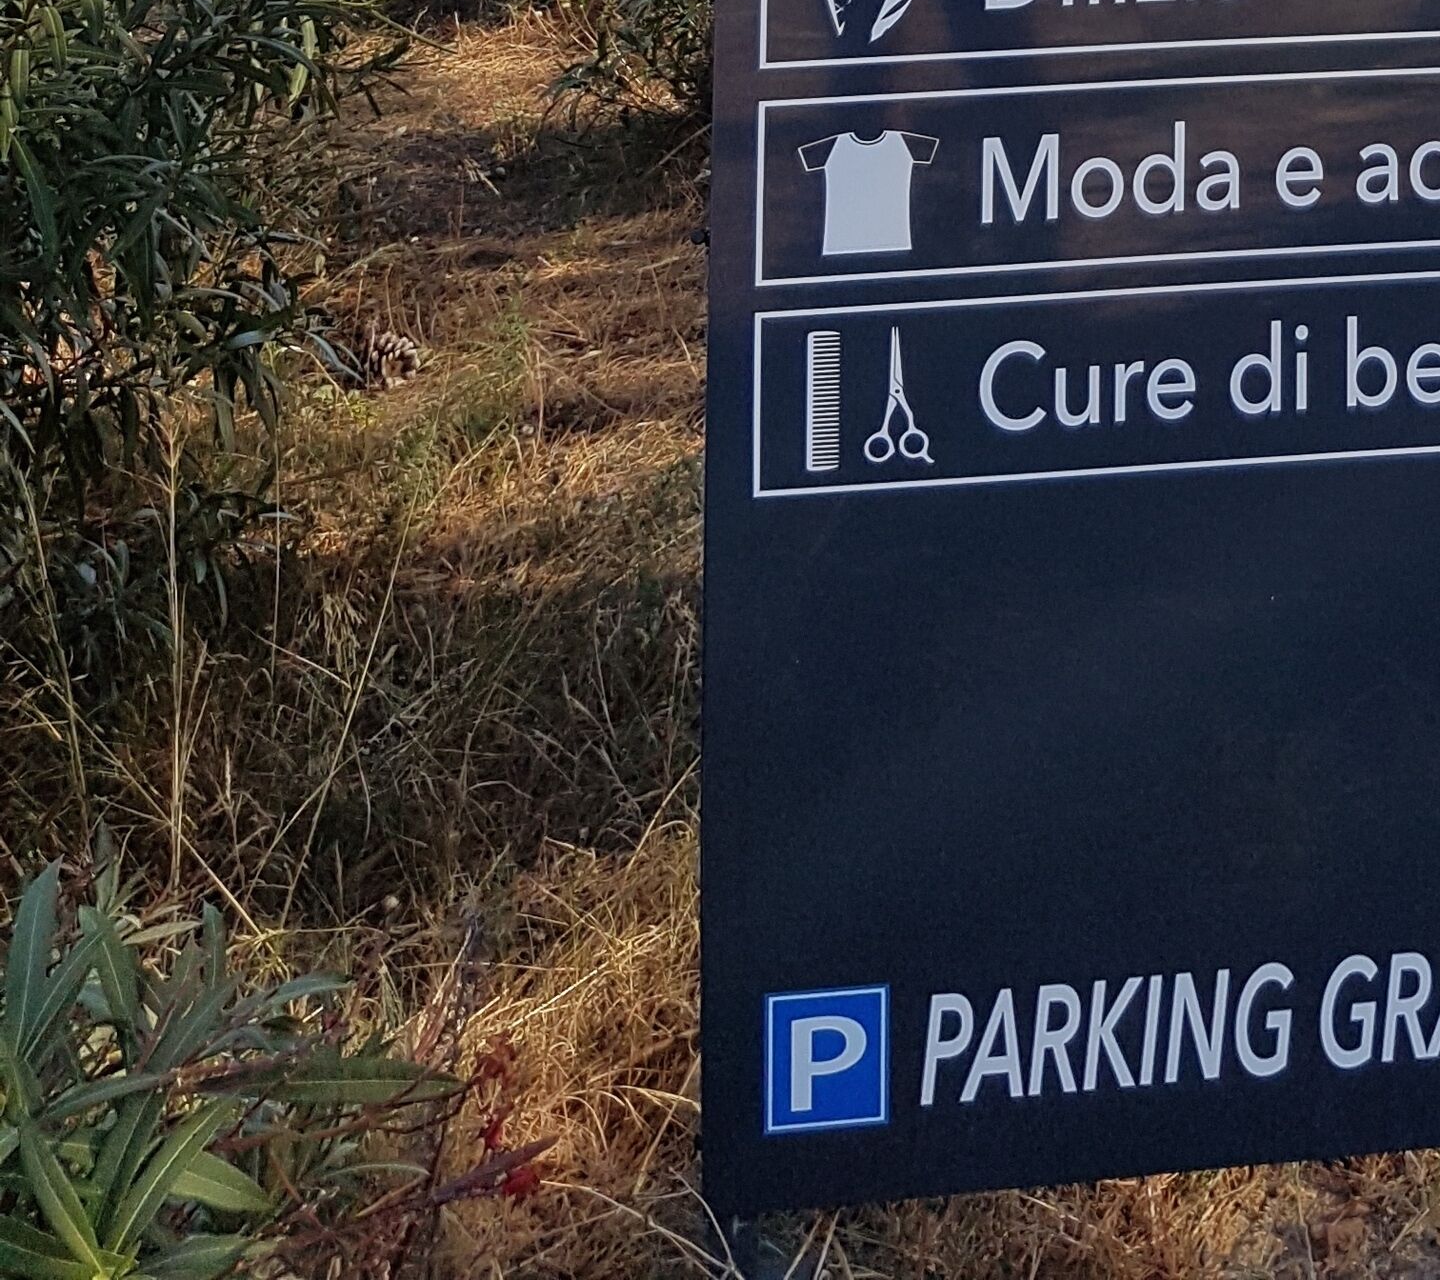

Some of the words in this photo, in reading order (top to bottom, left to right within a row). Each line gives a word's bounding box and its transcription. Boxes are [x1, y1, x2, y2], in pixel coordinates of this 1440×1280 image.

[981, 120, 1241, 224] Moda
[1275, 146, 1324, 207] e
[979, 340, 1197, 432] Cure
[1229, 319, 1309, 415] di
[789, 1015, 867, 1113] P
[920, 962, 1294, 1106] PARKING
